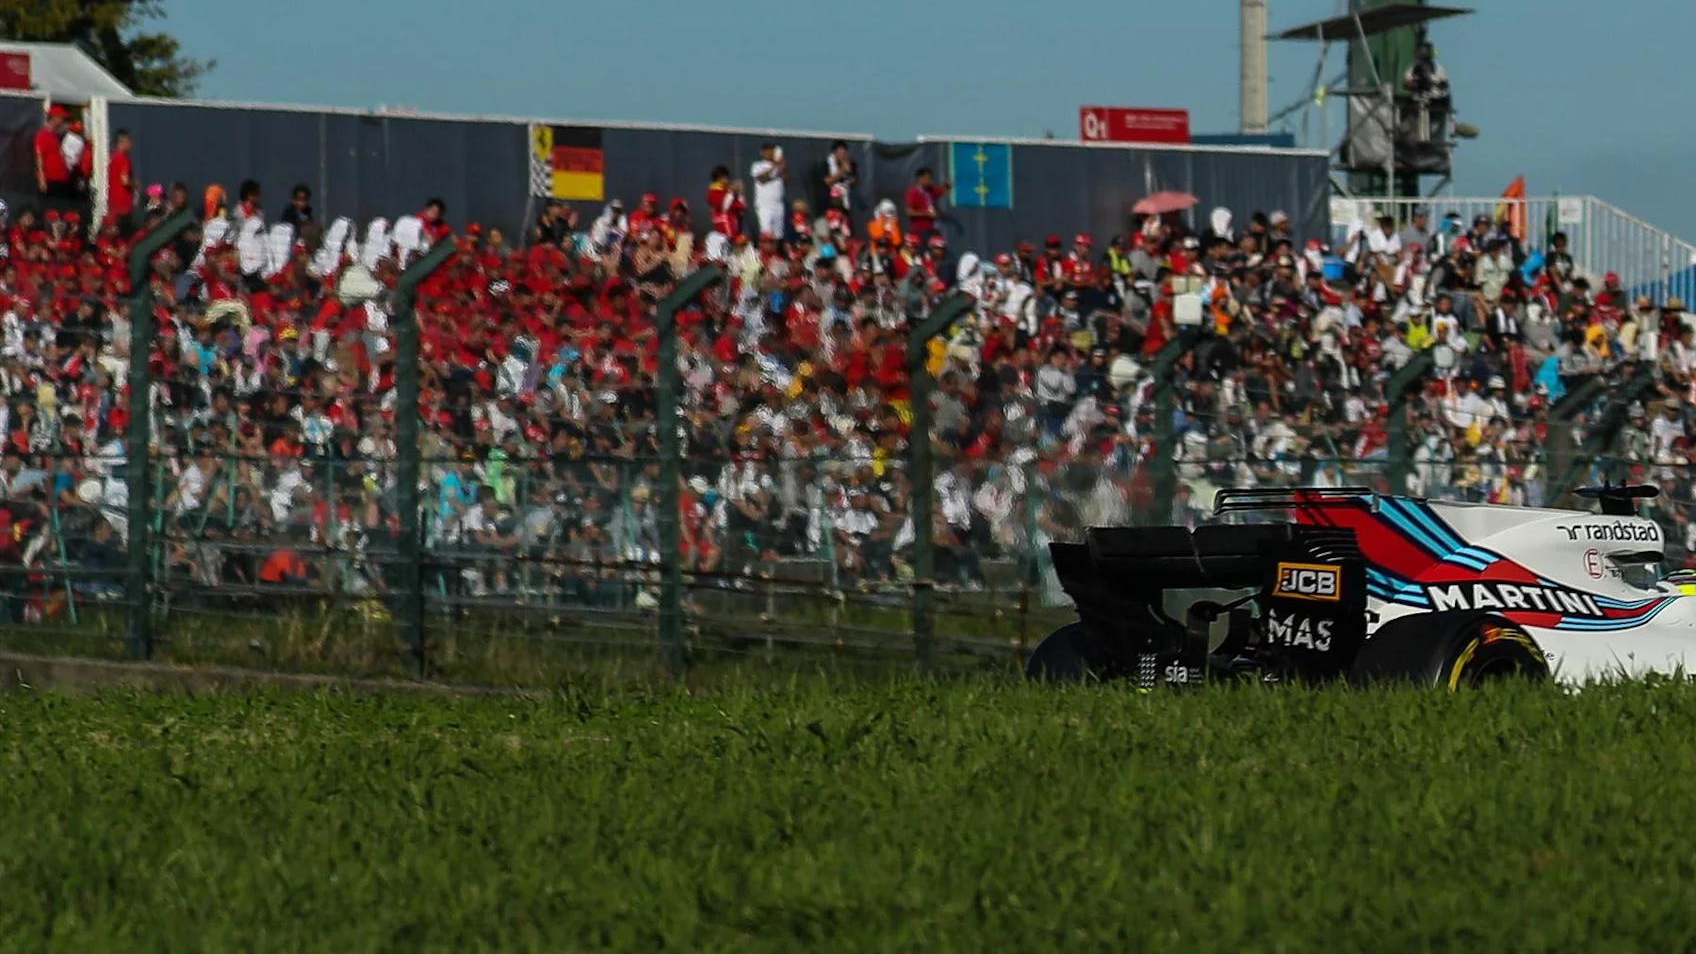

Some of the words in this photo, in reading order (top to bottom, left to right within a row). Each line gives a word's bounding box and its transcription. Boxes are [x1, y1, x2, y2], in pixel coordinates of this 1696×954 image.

[1585, 520, 1660, 542] randstad
[1280, 569, 1335, 595] JCB
[1427, 583, 1604, 617] MARTINI
[1267, 608, 1334, 652] MAS
[1164, 659, 1189, 683] sia
